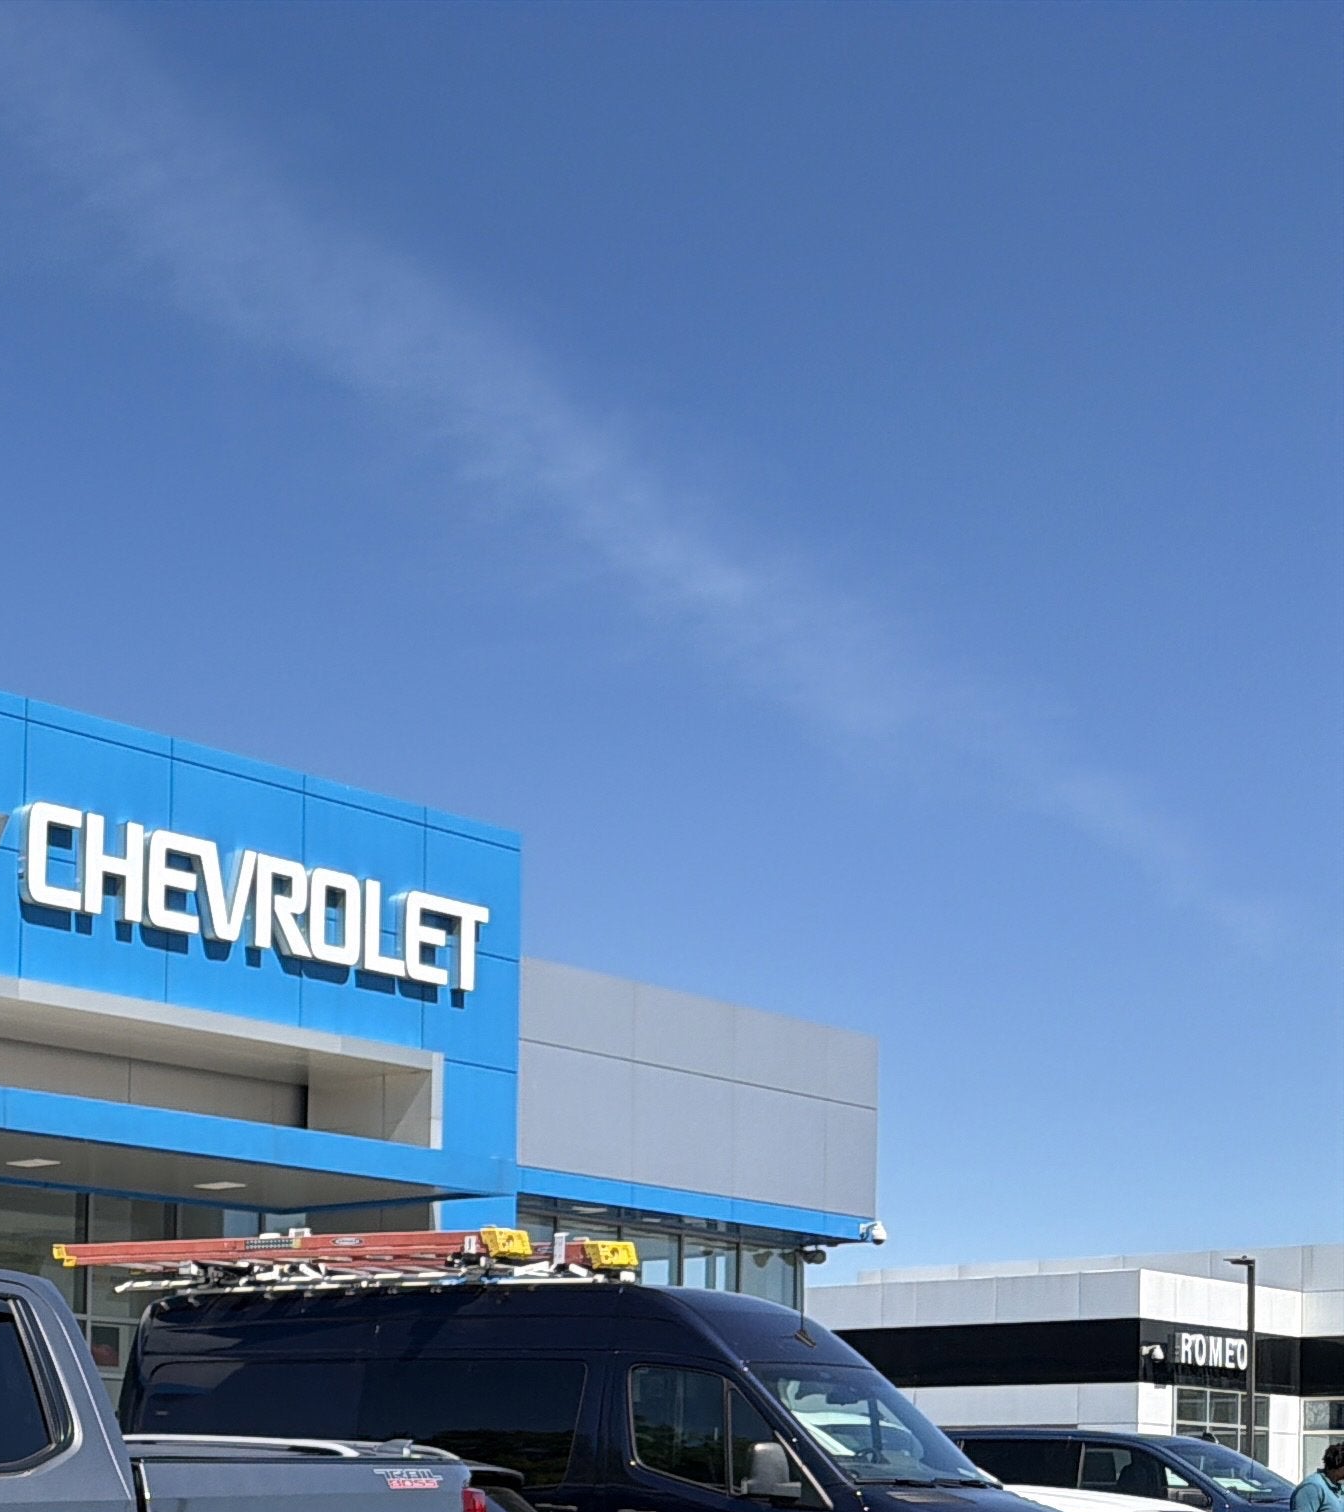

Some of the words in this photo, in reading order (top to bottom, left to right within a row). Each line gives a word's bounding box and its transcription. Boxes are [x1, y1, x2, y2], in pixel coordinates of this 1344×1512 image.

[19, 801, 490, 993] CHEVROLET
[1179, 1332, 1248, 1370] ROMEO
[373, 1468, 444, 1481] TRAIL
